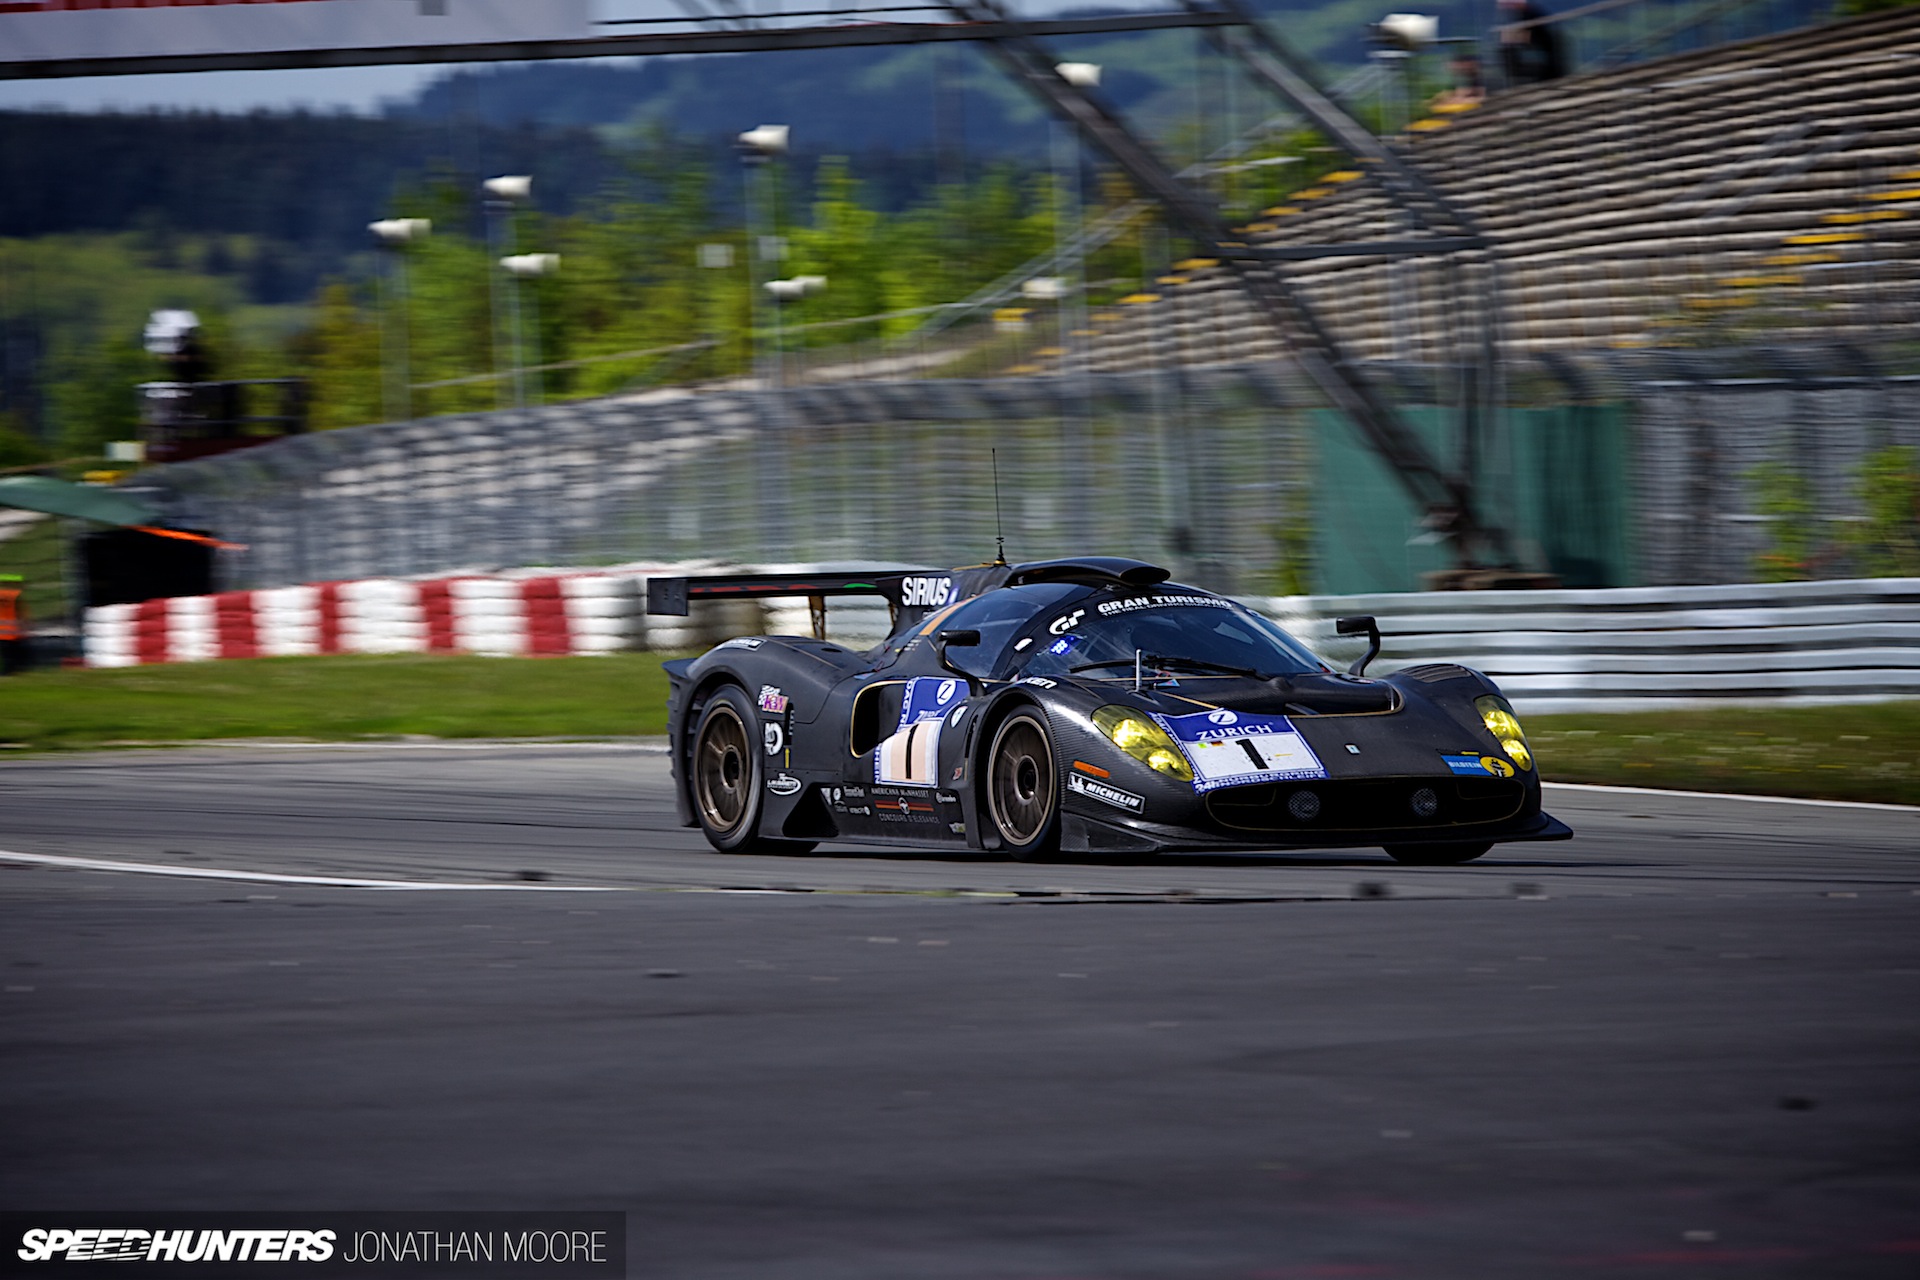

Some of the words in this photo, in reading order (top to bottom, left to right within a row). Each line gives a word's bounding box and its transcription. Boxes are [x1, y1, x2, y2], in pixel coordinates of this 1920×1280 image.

[901, 576, 952, 606] SIRIUS
[1097, 597, 1149, 614] GRAN
[1151, 595, 1232, 608] TURISMO
[1195, 724, 1273, 740] ZURICH
[905, 723, 920, 780] 1
[1235, 738, 1270, 770] 1
[1447, 761, 1483, 769] BILSTEIN
[1085, 782, 1141, 808] MICHELIN
